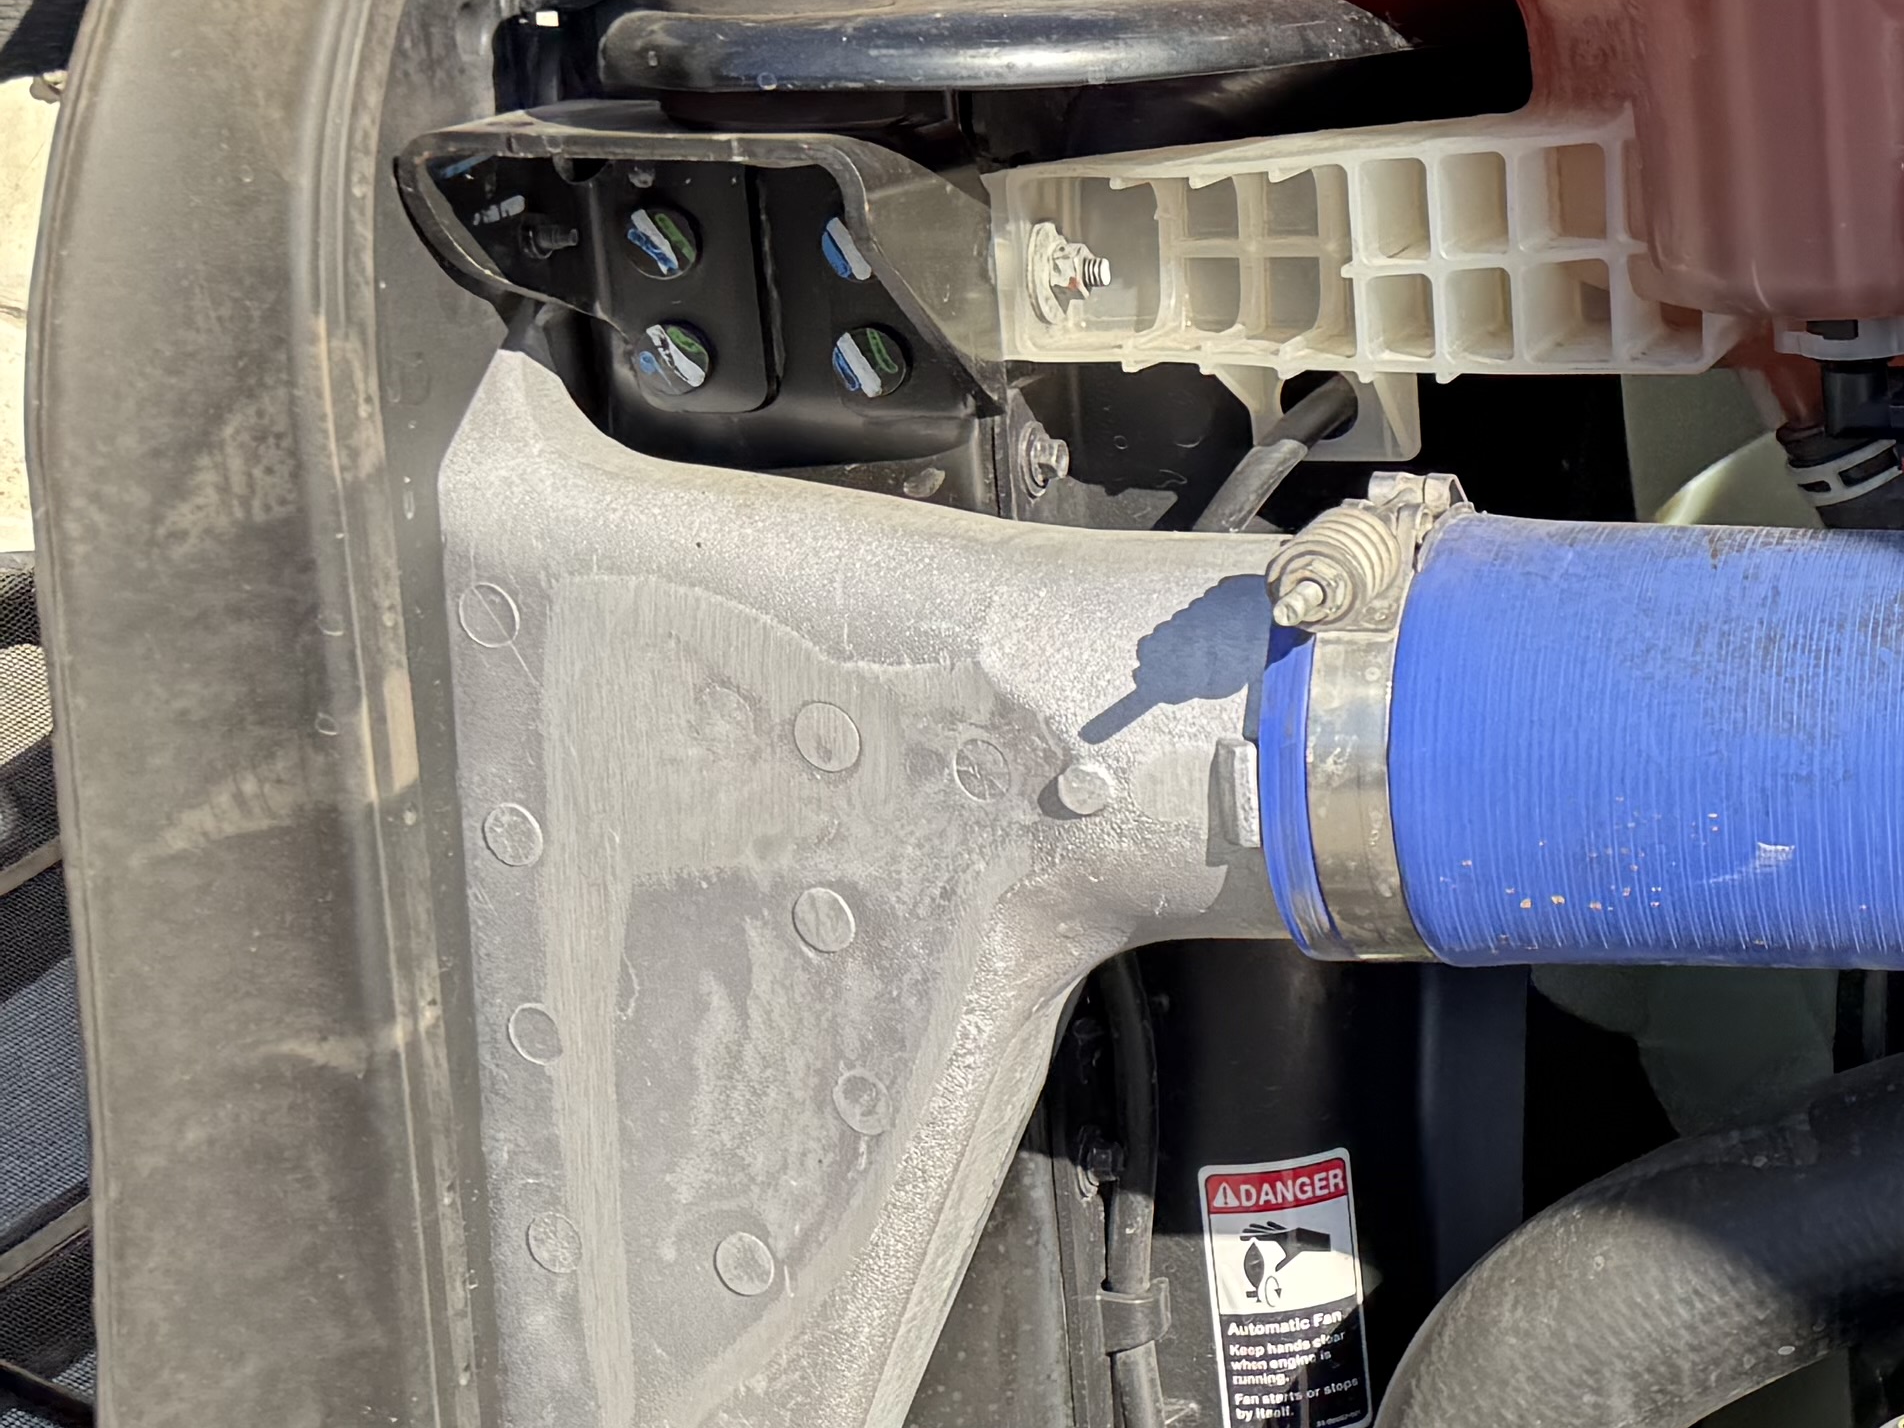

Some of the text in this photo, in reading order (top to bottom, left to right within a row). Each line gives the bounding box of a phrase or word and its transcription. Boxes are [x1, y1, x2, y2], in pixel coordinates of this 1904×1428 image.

[1239, 1169, 1345, 1208] DANGER
[1228, 1309, 1343, 1337] Automatic Fan
[1229, 1330, 1345, 1358] Keep hands clear
[1230, 1349, 1331, 1372] when engine is
[1234, 1376, 1359, 1406] Fan starts or stops
[1236, 1407, 1253, 1422] by
